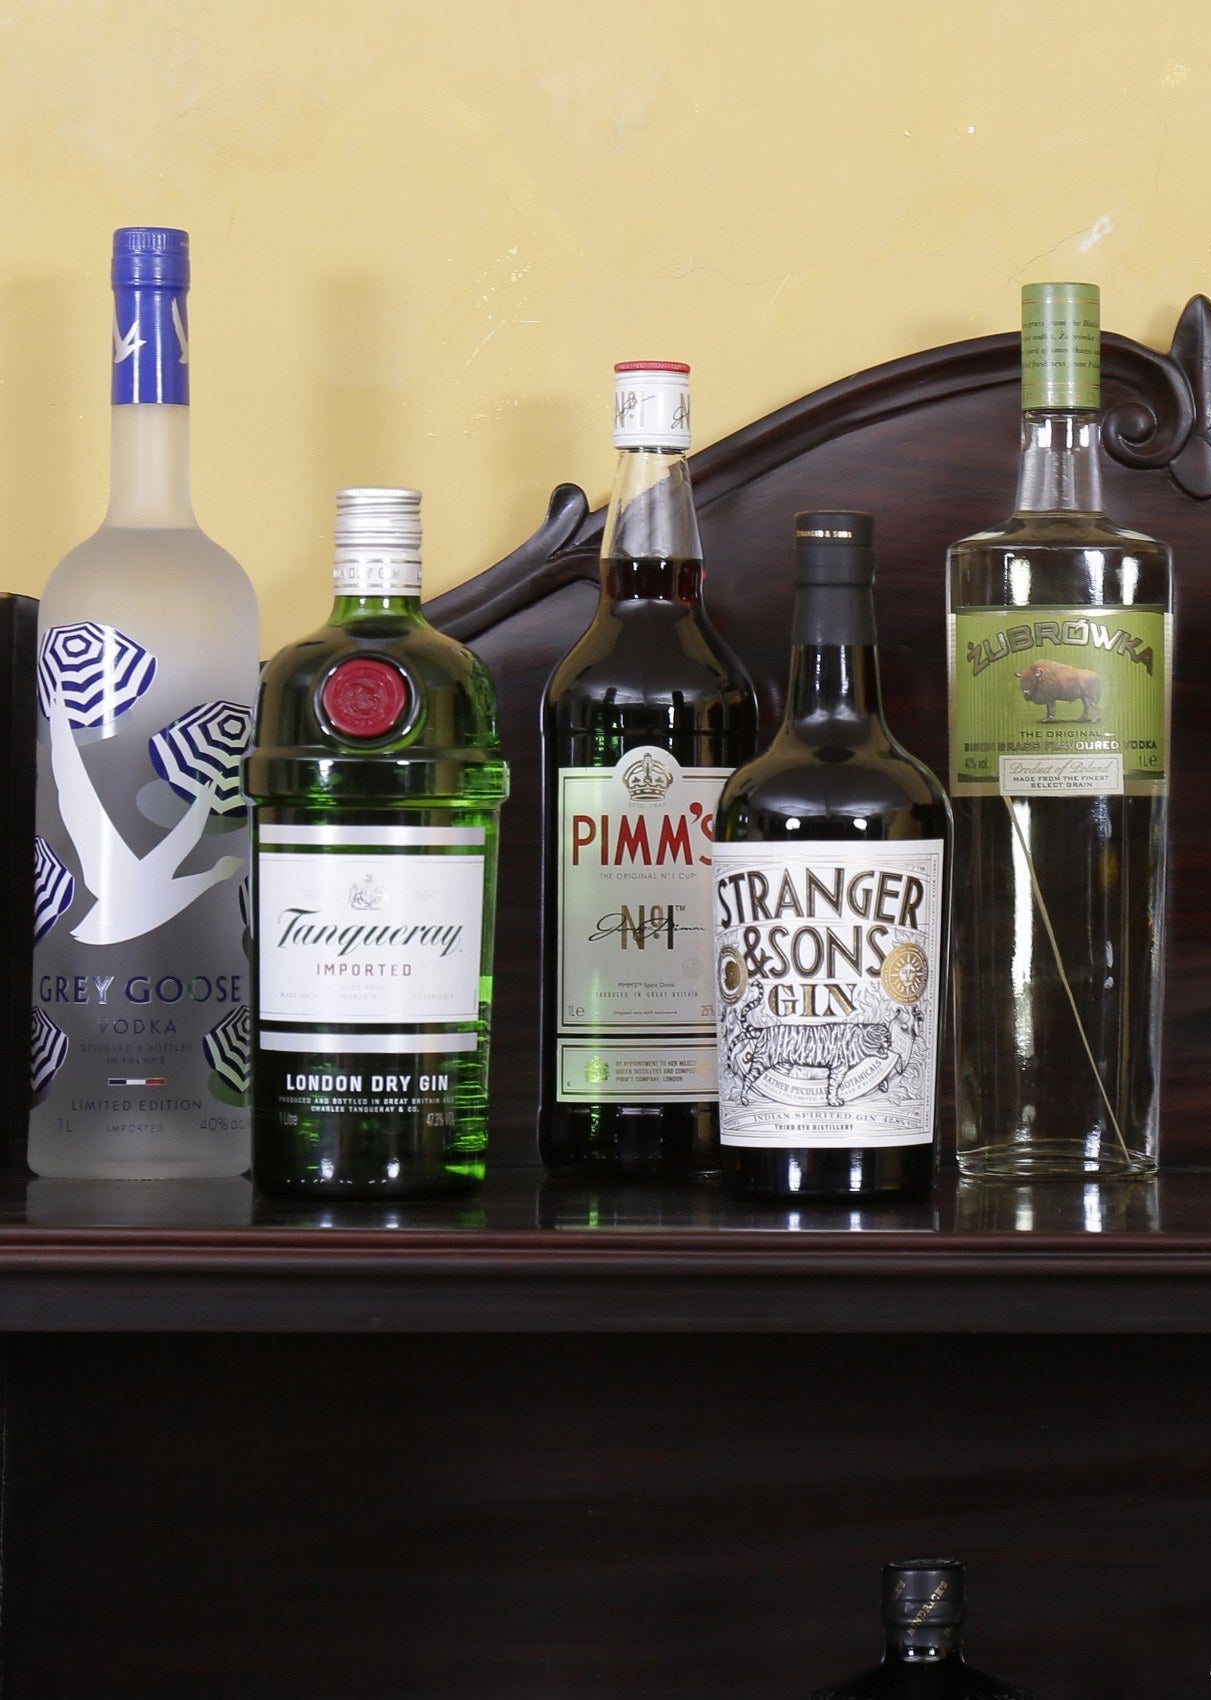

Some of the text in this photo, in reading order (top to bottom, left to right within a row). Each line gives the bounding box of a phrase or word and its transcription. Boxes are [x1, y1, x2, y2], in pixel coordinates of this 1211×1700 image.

[967, 618, 1154, 676] ŻUBRÓWKA
[1045, 741, 1119, 751] FLAVOURED
[1124, 741, 1157, 749] VODKA
[1009, 762, 1050, 774] Product
[717, 867, 924, 929] STRANGER
[277, 908, 463, 957] Tanqueray
[317, 963, 412, 977] IMPORTED
[39, 975, 241, 1005] GREY GOOSE
[768, 983, 857, 1018] GIN
[98, 1019, 177, 1035] VODKA
[286, 1074, 448, 1092] LONDON DRY GIN
[72, 1099, 202, 1111] LIMITED EDITION
[753, 1112, 789, 1123] INDIAN
[795, 1112, 851, 1120] SPIRITED
[108, 1124, 163, 1133] IMPORTED
